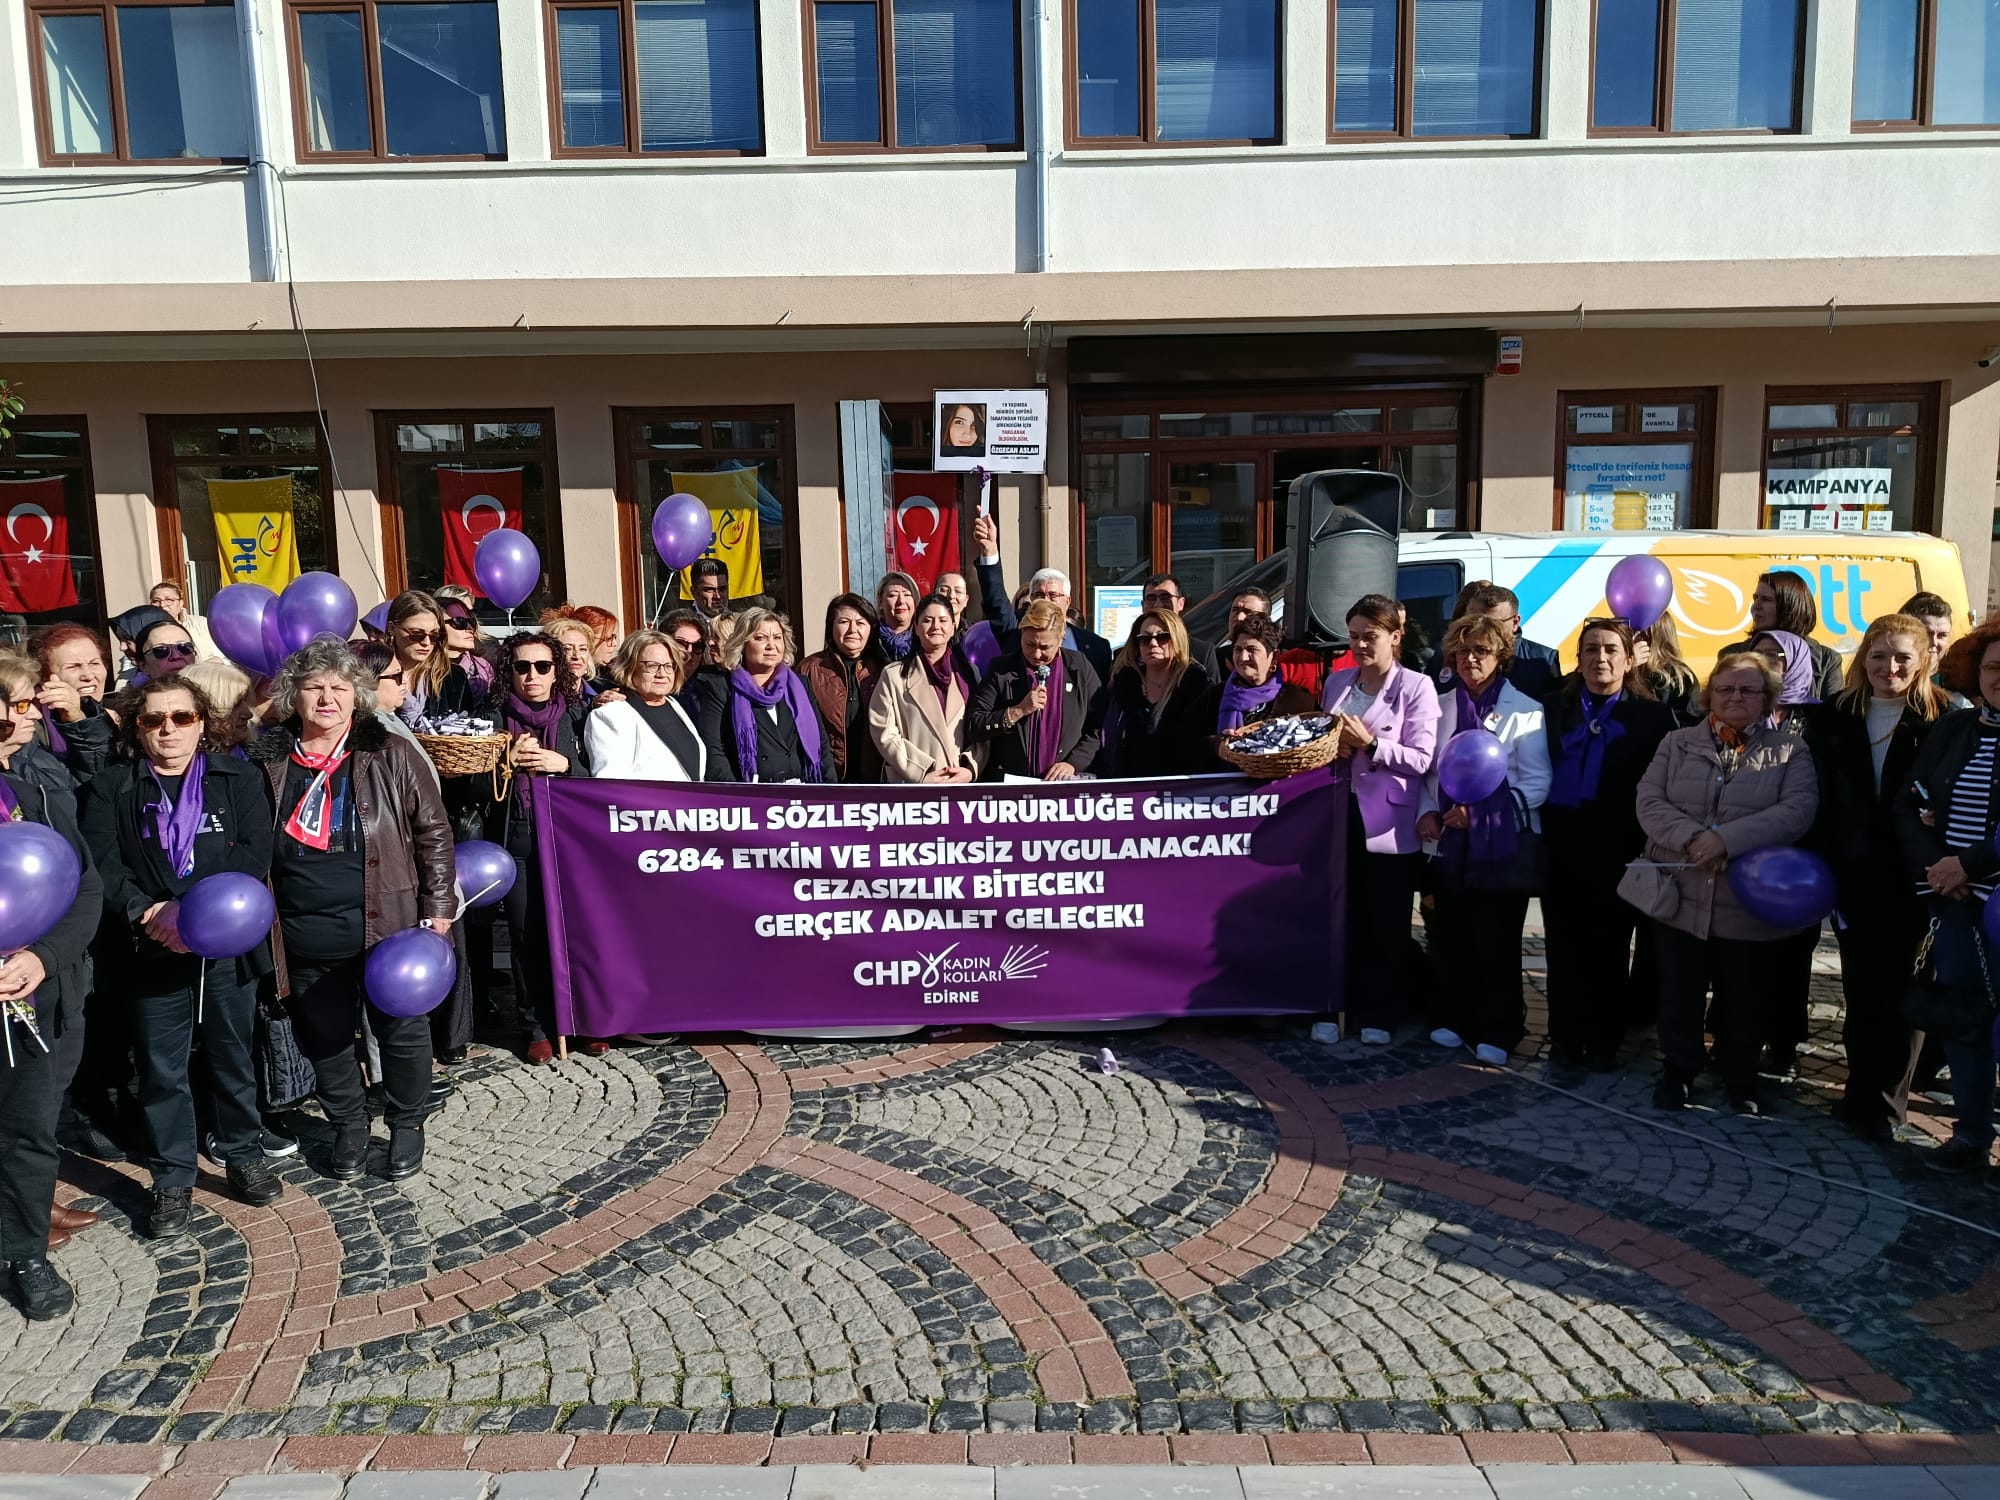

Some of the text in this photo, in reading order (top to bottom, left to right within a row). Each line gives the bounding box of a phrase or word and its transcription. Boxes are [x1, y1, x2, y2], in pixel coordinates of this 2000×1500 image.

[991, 446, 1018, 454] ÖZGECAN
[1616, 460, 1660, 471] tarifeniz
[1644, 473, 1666, 482] net!
[1768, 479, 1889, 494] KAMPANYA
[231, 538, 257, 574] Ptt
[608, 791, 1279, 833] İSTANBUL SÖZLEŞMESİ YÜRÜRLÜĞE GİRECEK!
[638, 833, 1252, 873] 6284 ETKİN VE EKSİKSİZ UYGULANACAK!
[794, 868, 1105, 901] CEZASIZLIK BİTECEK!
[755, 904, 1144, 940] GERÇEK ADALET GELECEK!
[943, 957, 990, 970] KADIN
[853, 960, 921, 986] CHP
[943, 970, 1002, 984] KOLLARI
[923, 989, 979, 1004] EDİRNE
